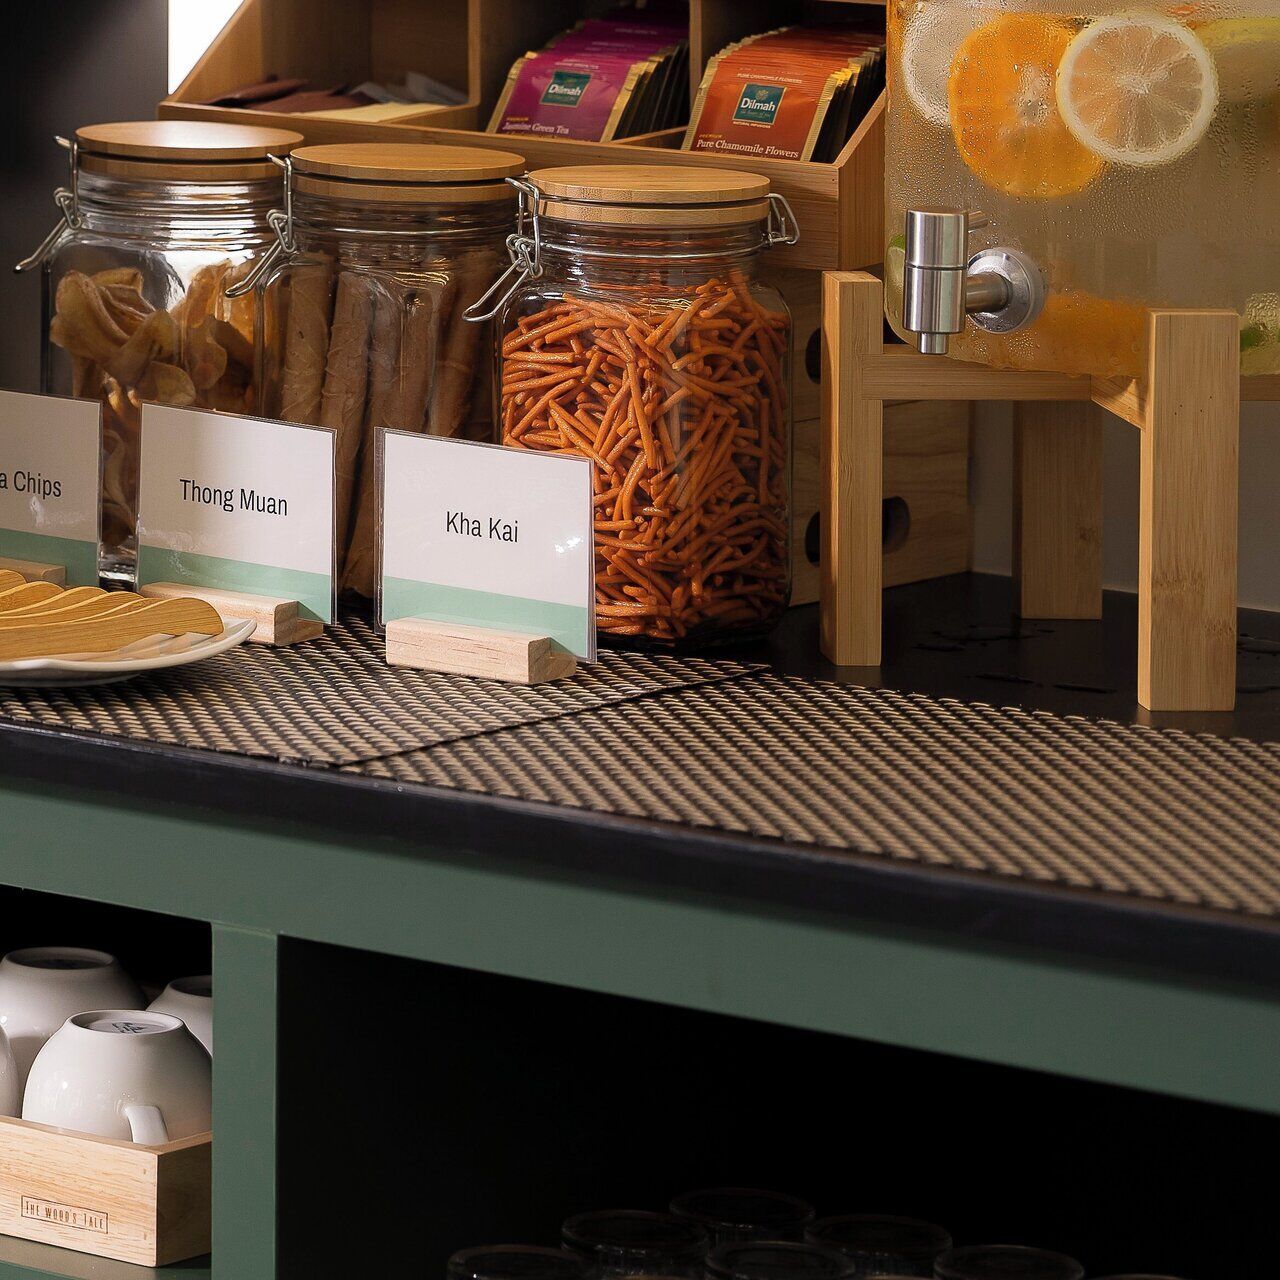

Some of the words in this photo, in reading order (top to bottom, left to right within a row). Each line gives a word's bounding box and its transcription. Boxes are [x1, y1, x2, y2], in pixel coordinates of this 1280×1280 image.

[548, 84, 581, 96] Dilmah
[740, 97, 776, 112] Dilmah
[502, 122, 532, 131] Jasmine
[532, 122, 555, 133] Green
[556, 125, 569, 135] Tea
[697, 139, 714, 148] Pure
[715, 140, 764, 154] Chamomile
[765, 145, 799, 158] Flowers
[13, 471, 61, 500] Chips
[180, 479, 234, 512] Thong
[240, 488, 288, 516] Muan
[446, 511, 482, 537] Kha
[489, 517, 518, 542] Kai
[25, 1201, 40, 1216] THE
[83, 1213, 104, 1229] TALE
